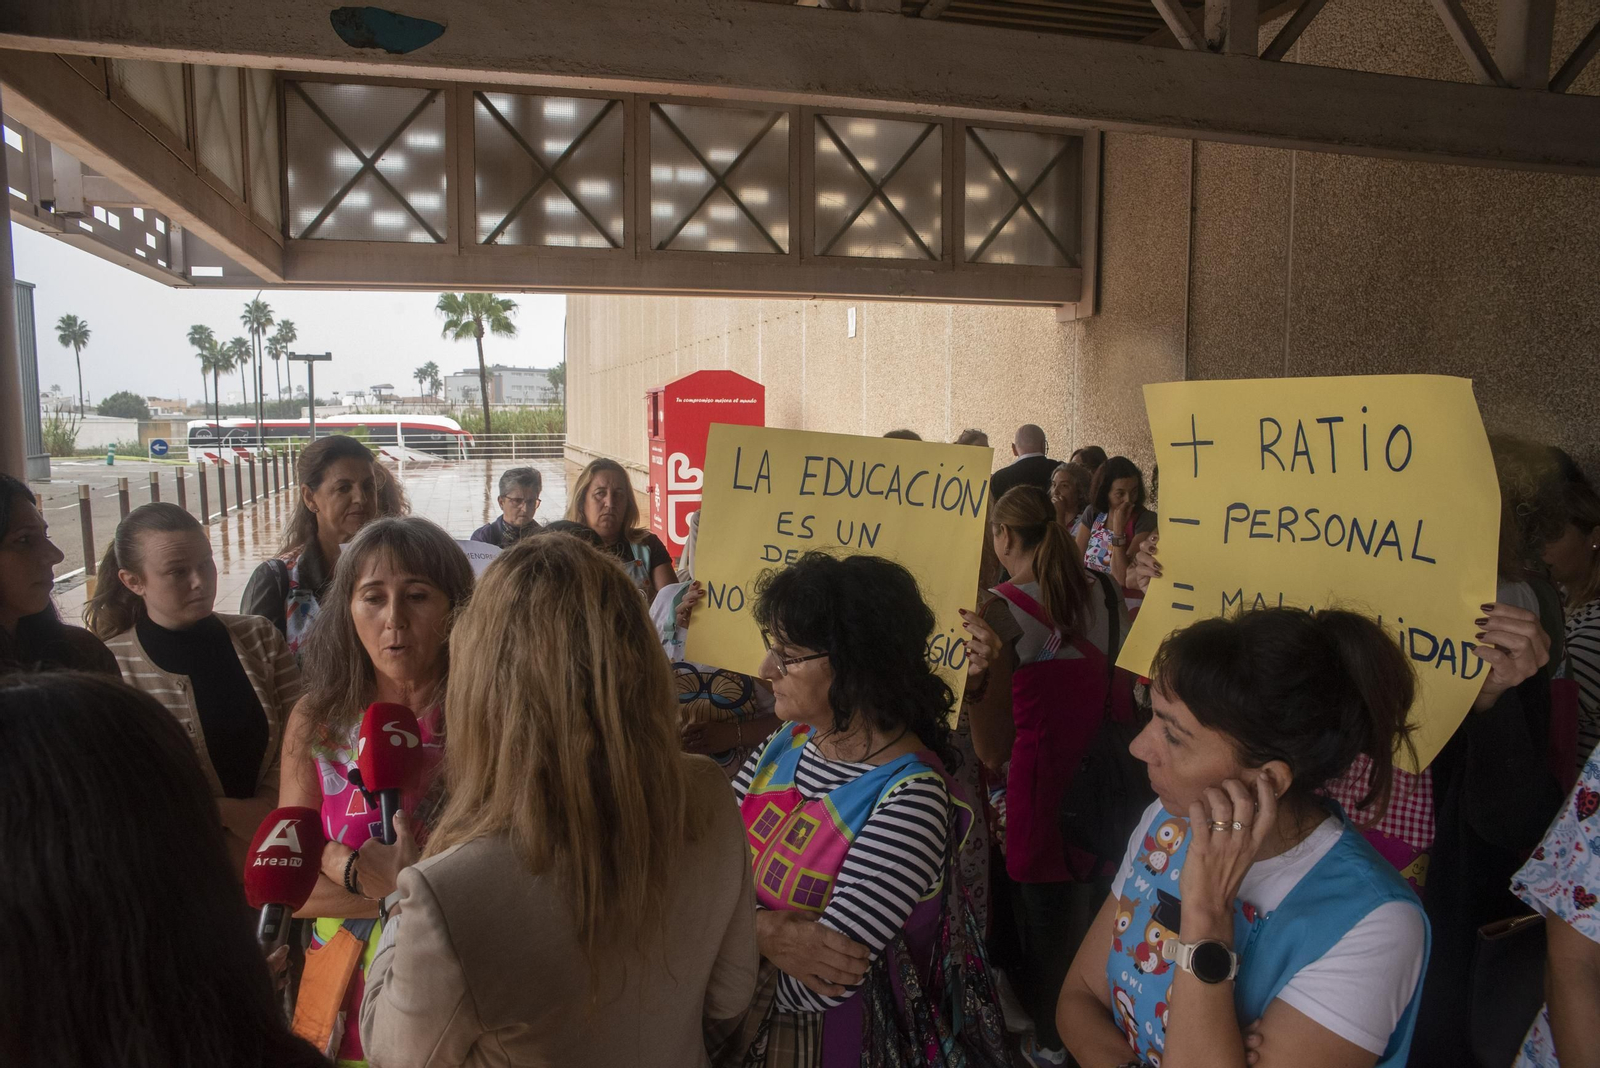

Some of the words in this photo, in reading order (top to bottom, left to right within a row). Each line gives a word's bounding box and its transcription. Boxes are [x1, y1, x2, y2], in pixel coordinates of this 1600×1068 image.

[733, 447, 771, 494] LA
[799, 455, 988, 518] EDUCACIÓN
[777, 511, 816, 539] ES
[837, 519, 881, 549] UN
[1223, 502, 1437, 564] PERSONAL
[707, 581, 744, 612] NO
[1121, 970, 1143, 995] OWL
